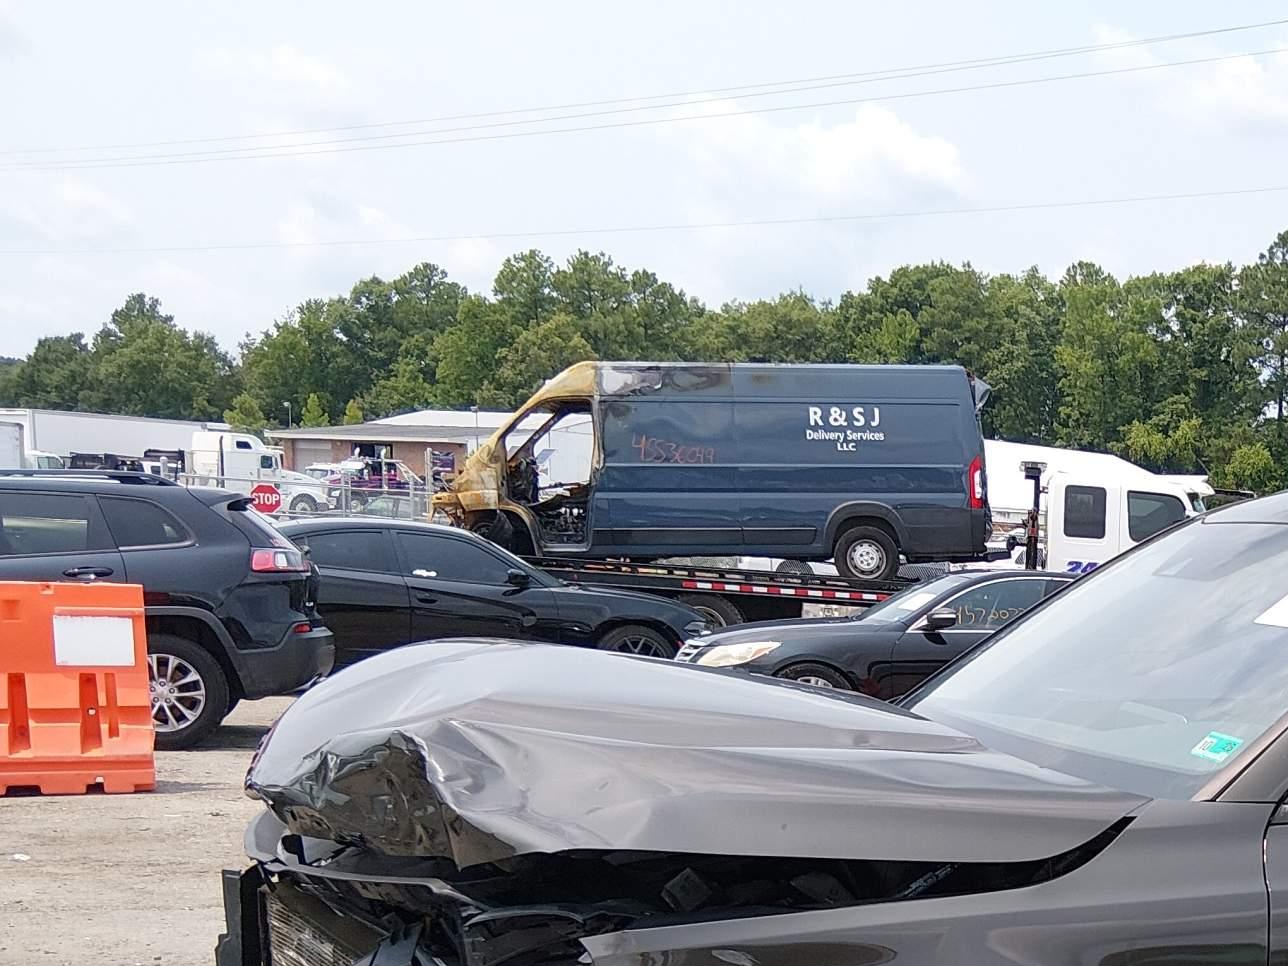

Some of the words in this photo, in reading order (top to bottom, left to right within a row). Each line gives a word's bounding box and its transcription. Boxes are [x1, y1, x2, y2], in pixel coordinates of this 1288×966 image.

[808, 406, 825, 427] R
[828, 406, 848, 427] &
[852, 406, 866, 427] S
[870, 407, 880, 427] J
[805, 430, 845, 443] Delivery
[846, 430, 885, 441] Services
[836, 442, 857, 452] LLC
[251, 492, 281, 506] STOP
